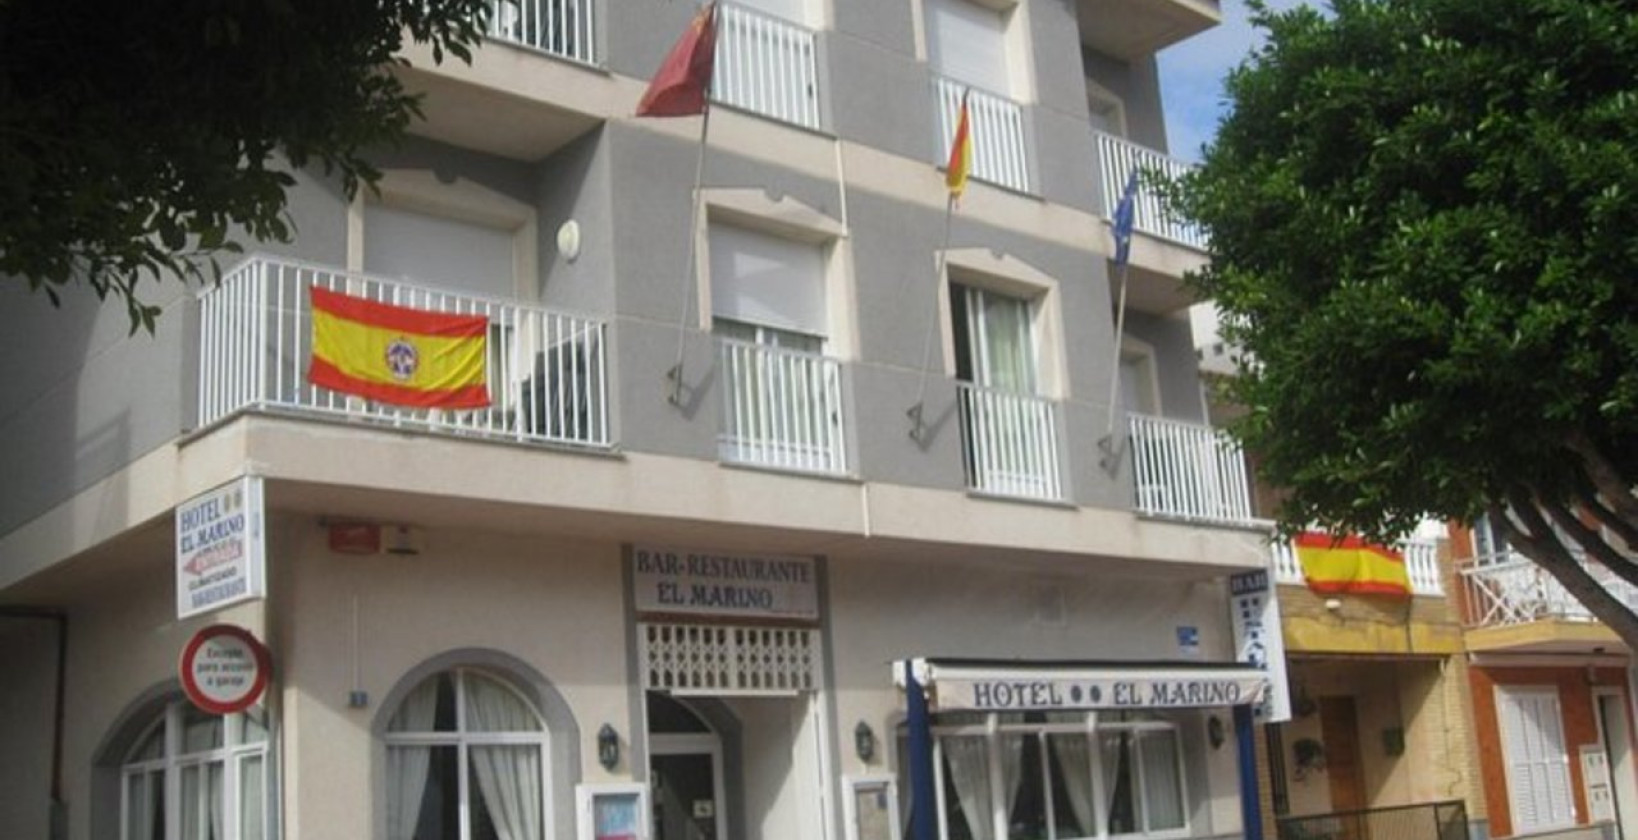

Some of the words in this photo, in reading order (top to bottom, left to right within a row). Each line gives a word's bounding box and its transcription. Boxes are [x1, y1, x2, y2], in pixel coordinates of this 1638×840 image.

[181, 497, 220, 533] HOTEL
[198, 513, 245, 547] MARINO
[636, 551, 810, 583] BAR-RESTAURANTE
[656, 582, 684, 605] EL
[689, 584, 774, 609] MARINO
[973, 682, 1063, 708] HOTEL
[1111, 682, 1143, 706] EL
[1149, 681, 1241, 705] MARINO
